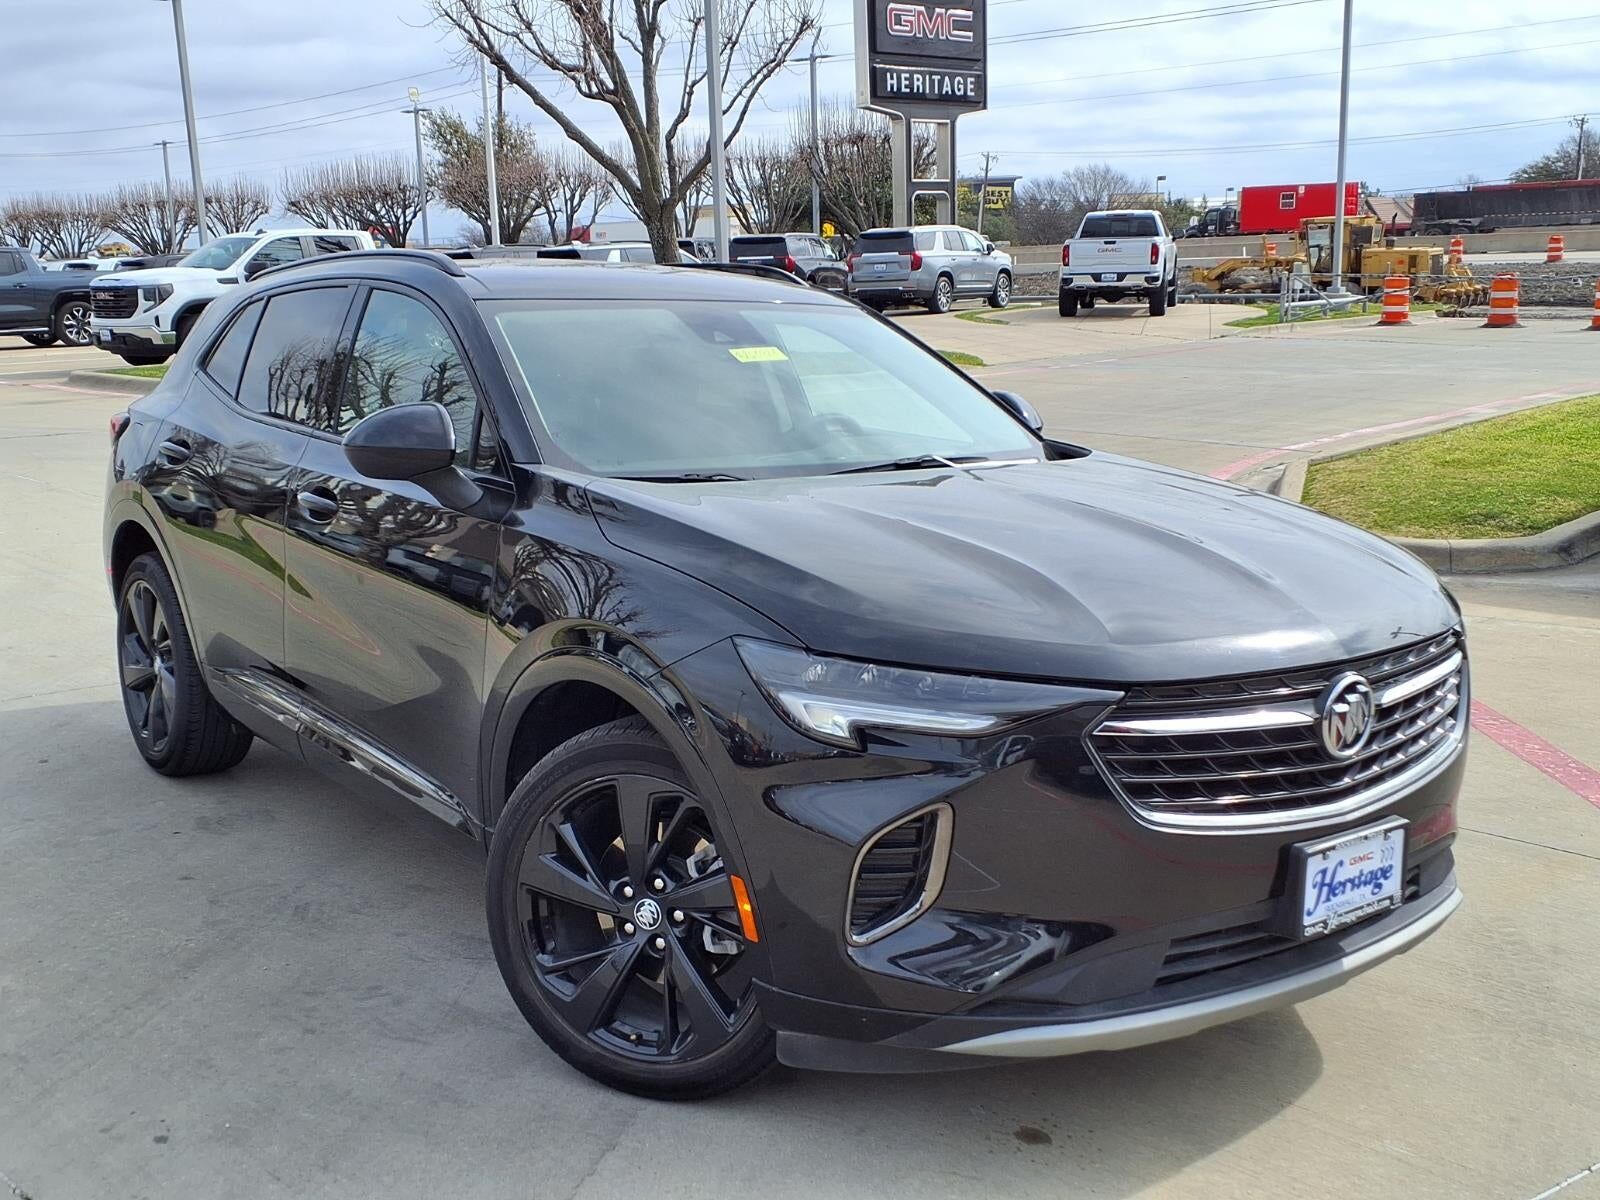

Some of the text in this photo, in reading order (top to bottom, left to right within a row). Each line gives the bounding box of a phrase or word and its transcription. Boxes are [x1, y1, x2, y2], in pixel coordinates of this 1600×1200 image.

[887, 3, 973, 42] GMC
[886, 72, 975, 96] HERITAGE
[985, 190, 1009, 198] BEST
[985, 198, 1006, 207] BUY
[1349, 851, 1374, 866] GMC
[1306, 859, 1394, 917] Heritage
